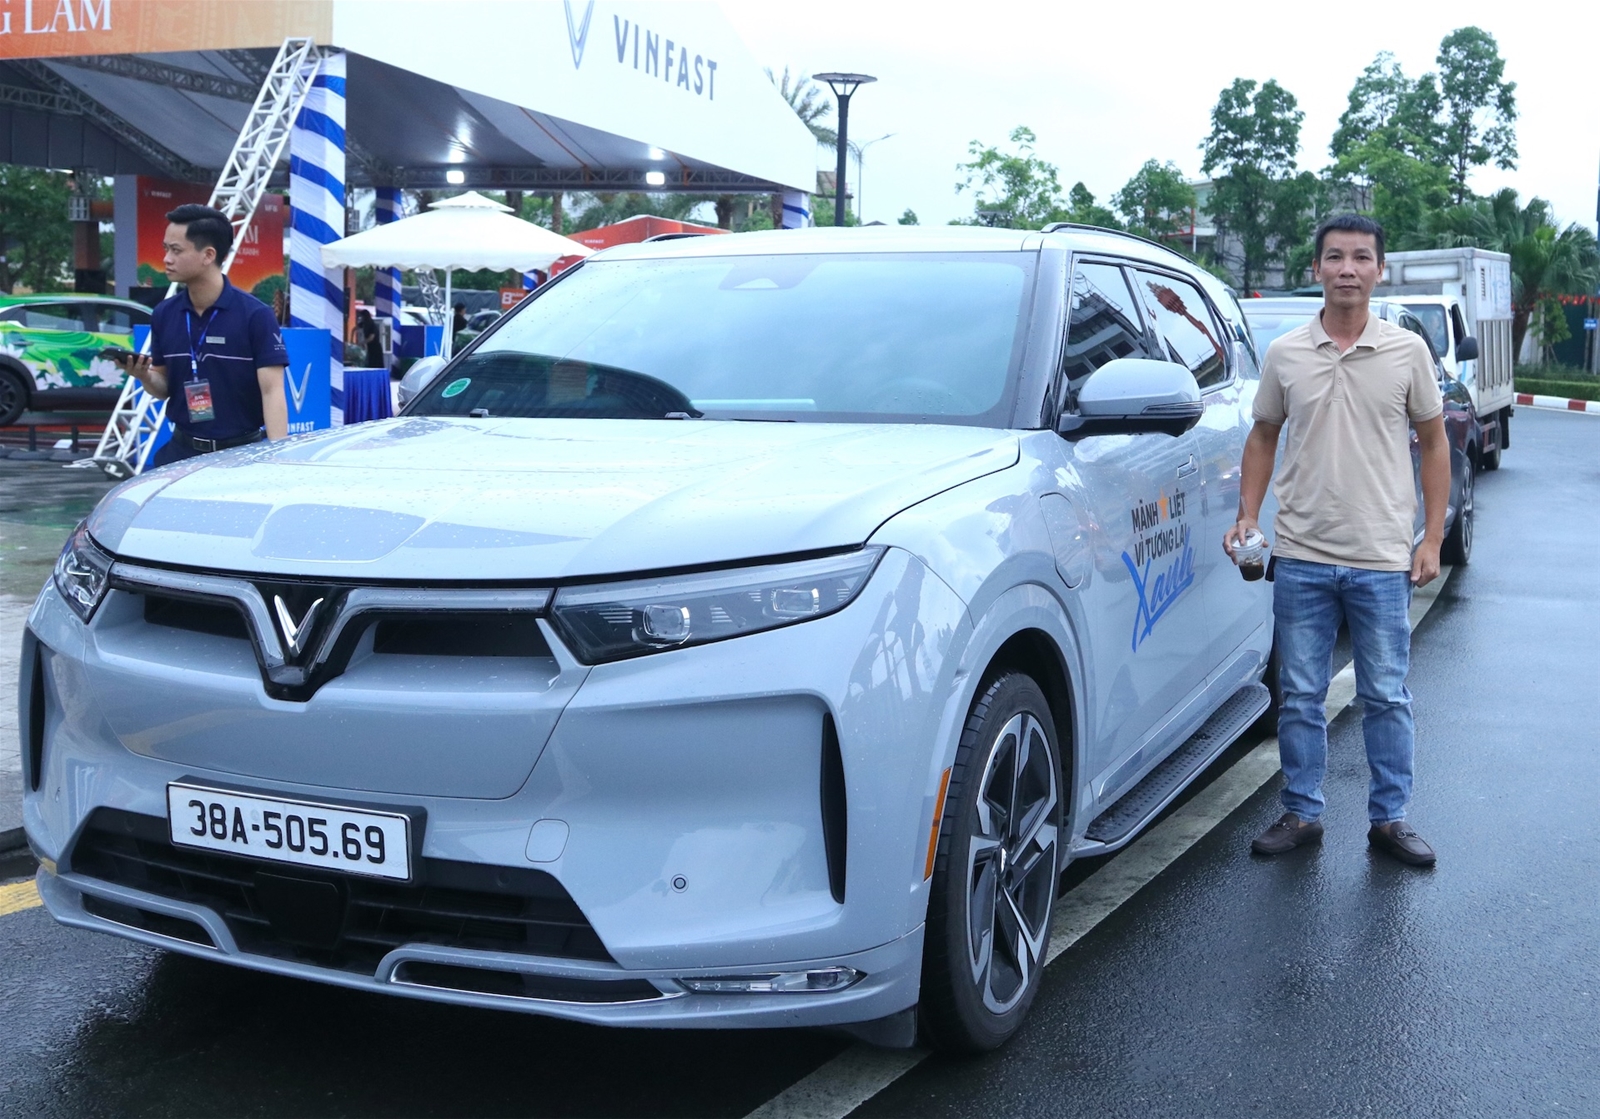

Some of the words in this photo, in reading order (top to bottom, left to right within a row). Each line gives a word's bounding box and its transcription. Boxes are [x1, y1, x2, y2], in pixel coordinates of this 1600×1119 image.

[613, 14, 718, 101] VINFAST
[287, 421, 315, 434] INFAST
[1134, 533, 1145, 567] VÌ
[1145, 529, 1174, 560] TƯƠNG
[1121, 526, 1197, 654] Xanh
[188, 799, 386, 865] 38A-505.69
